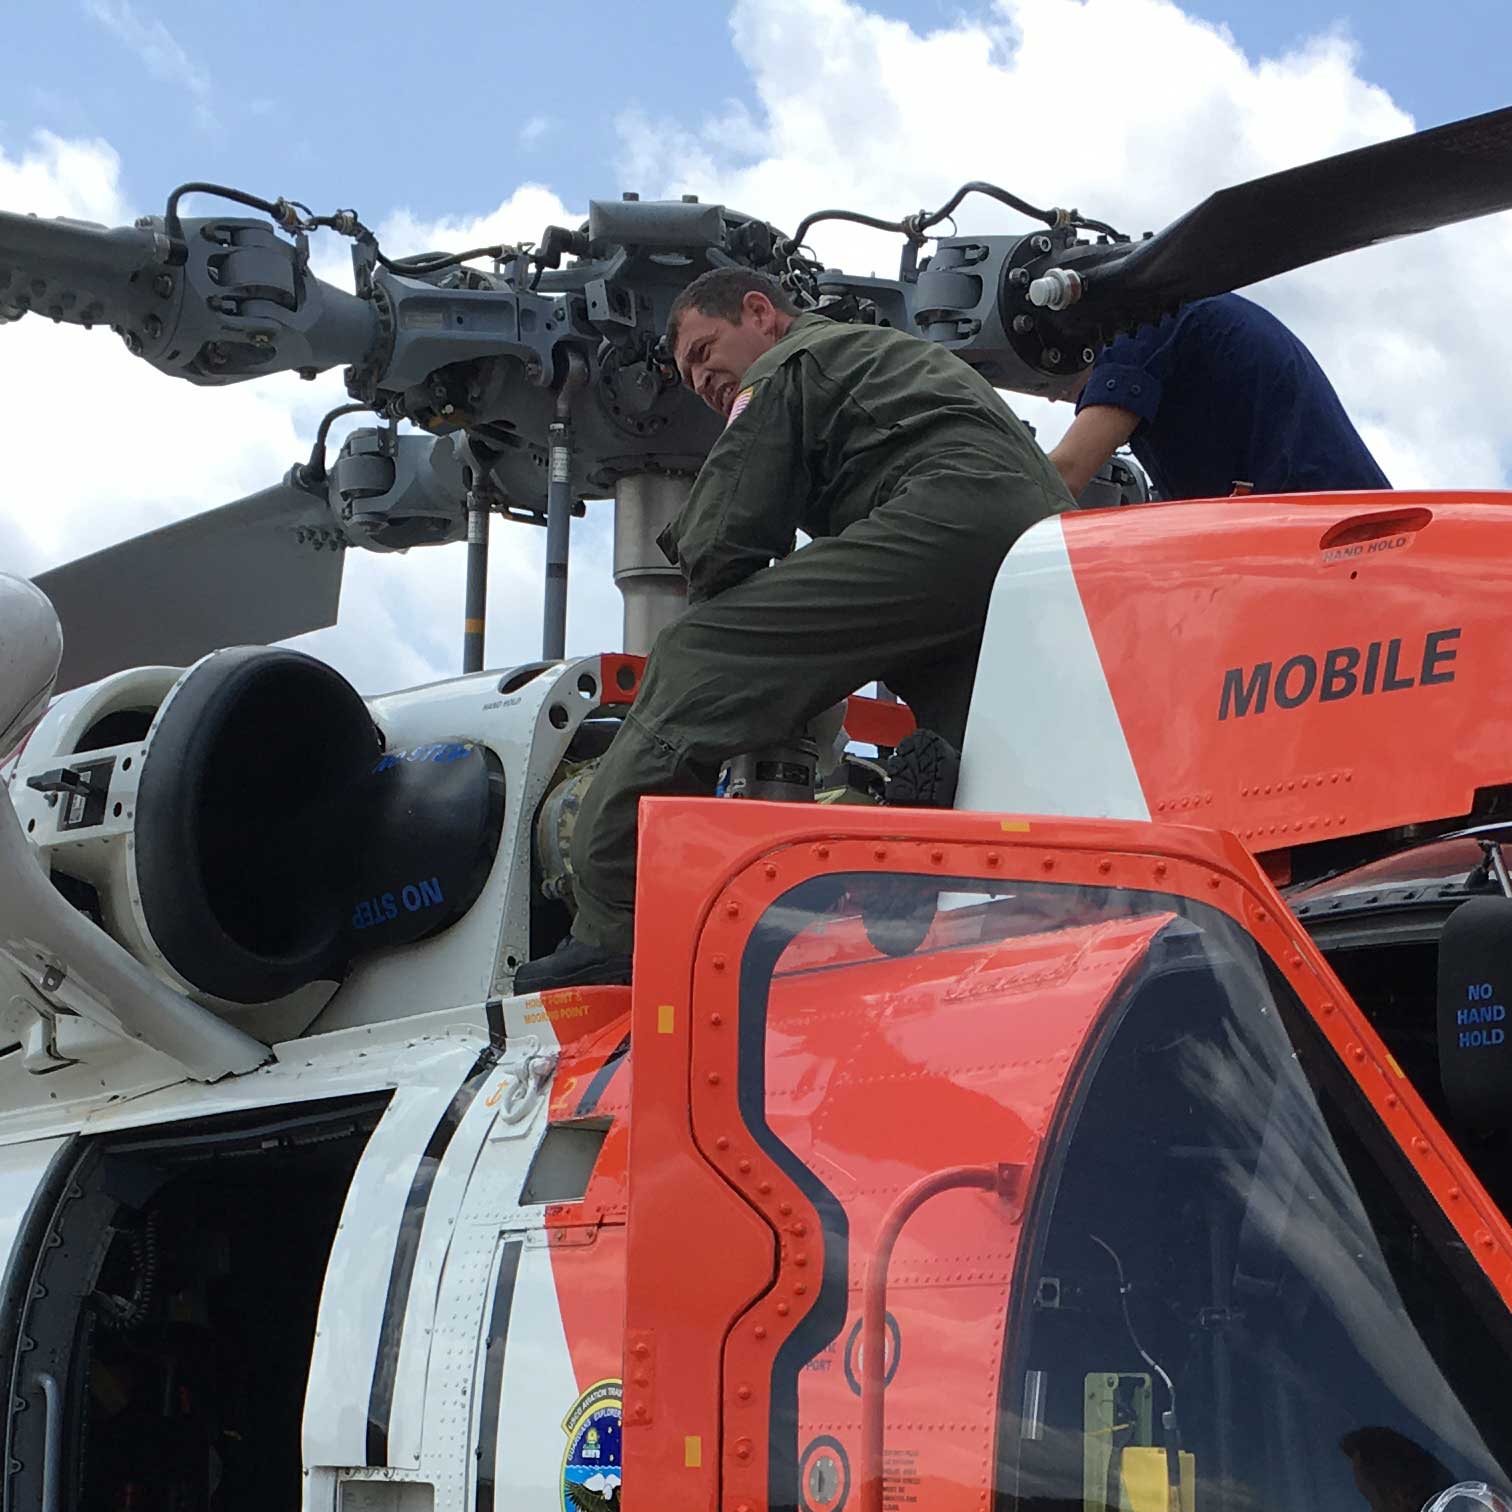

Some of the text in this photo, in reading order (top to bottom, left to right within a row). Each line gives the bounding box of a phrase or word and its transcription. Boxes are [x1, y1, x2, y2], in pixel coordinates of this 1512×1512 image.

[1322, 537, 1406, 563] HAND HOLD
[1217, 627, 1462, 721] MOBILE
[352, 877, 445, 929] NO STEP
[1468, 983, 1493, 1000] NO
[560, 1005, 590, 1019] POINT
[1457, 1005, 1506, 1025] HAND
[1459, 1028, 1505, 1048] HOLD
